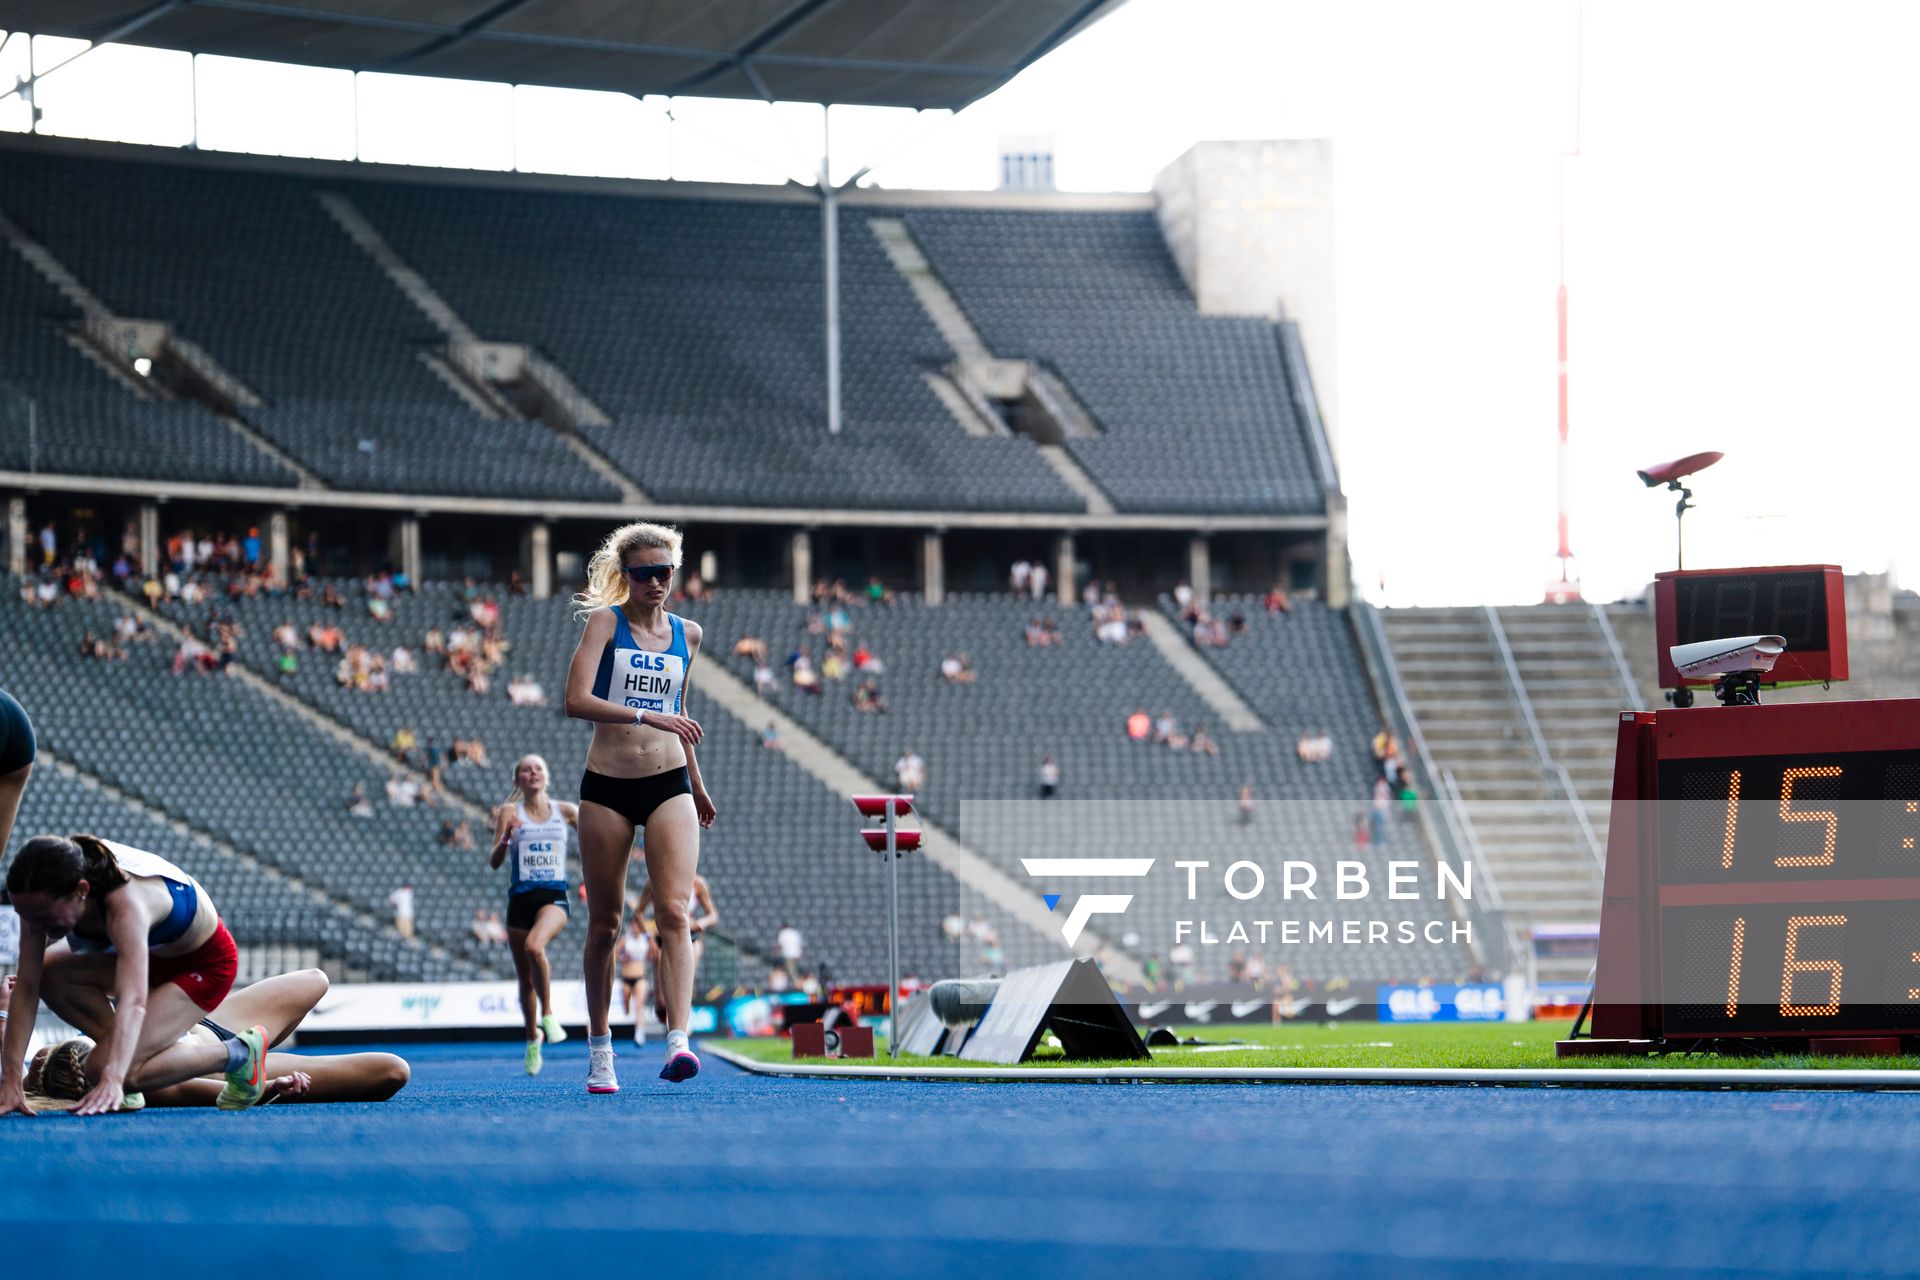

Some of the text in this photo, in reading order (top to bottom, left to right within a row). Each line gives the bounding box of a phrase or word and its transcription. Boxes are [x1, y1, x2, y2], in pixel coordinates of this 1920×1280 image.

[624, 673, 671, 695] HEIM
[641, 700, 662, 709] PLAN
[523, 855, 560, 867] HECKEL
